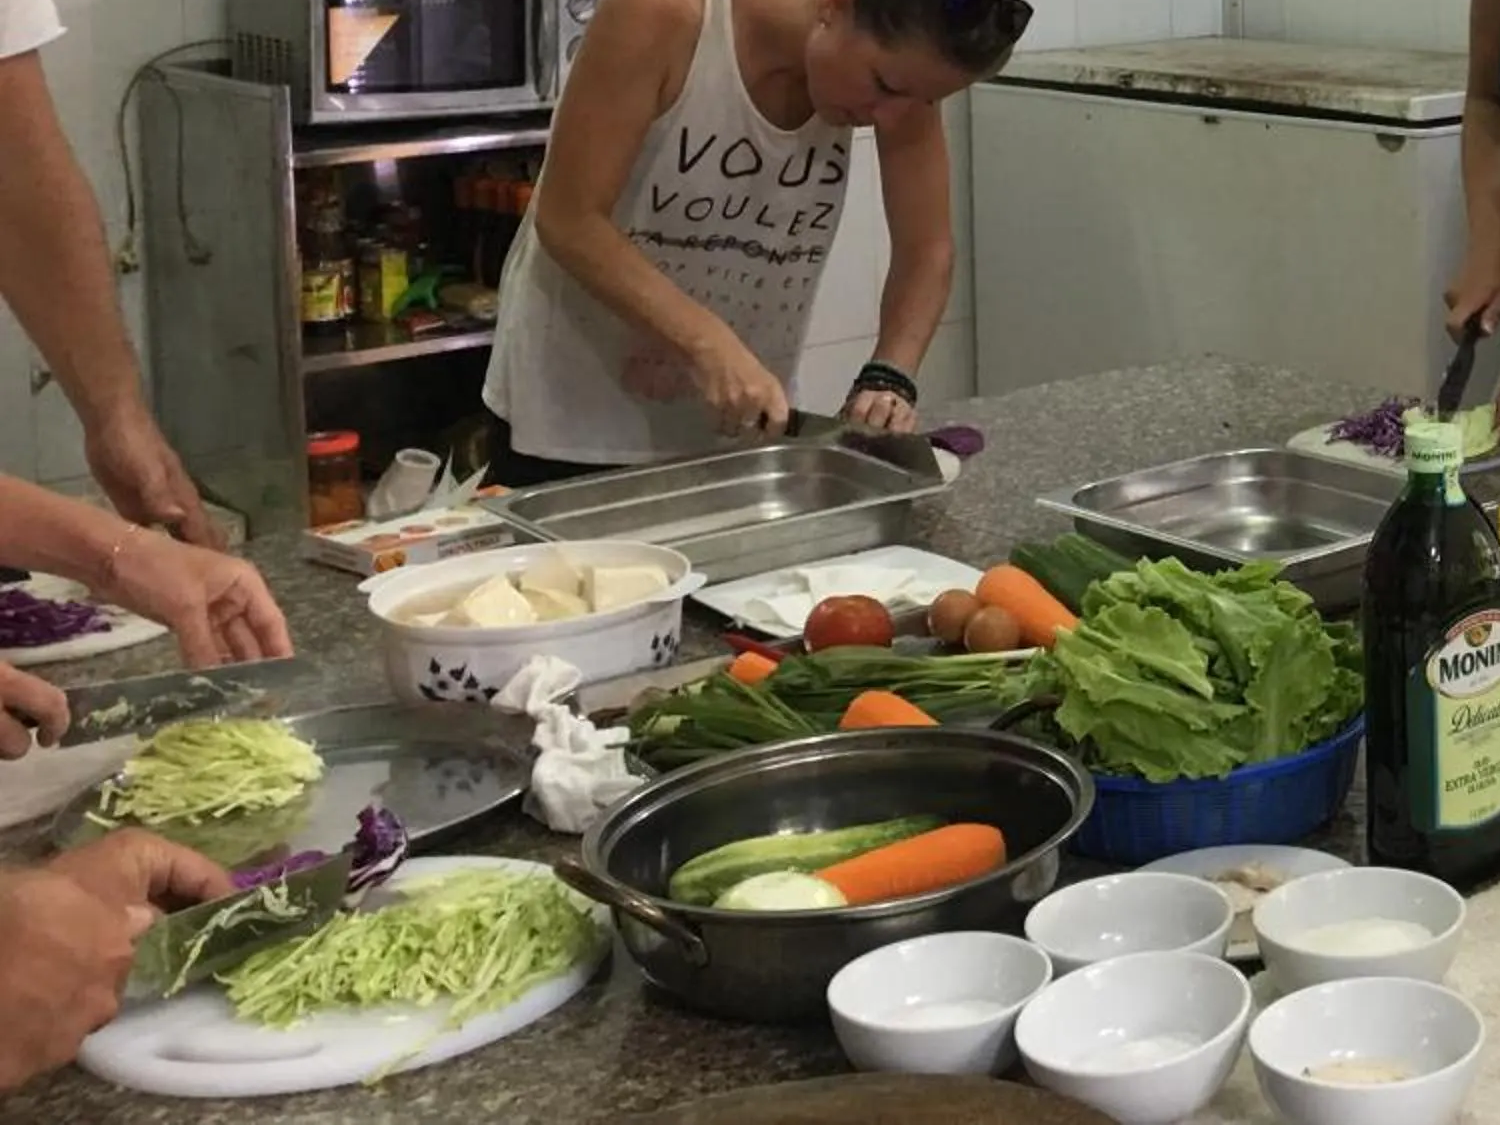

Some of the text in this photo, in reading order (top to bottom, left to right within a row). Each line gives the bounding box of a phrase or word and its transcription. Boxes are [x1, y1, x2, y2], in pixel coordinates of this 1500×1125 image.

[678, 127, 846, 187] VOUS
[653, 183, 835, 237] VOULEZ
[1444, 771, 1477, 792] EXTRA
